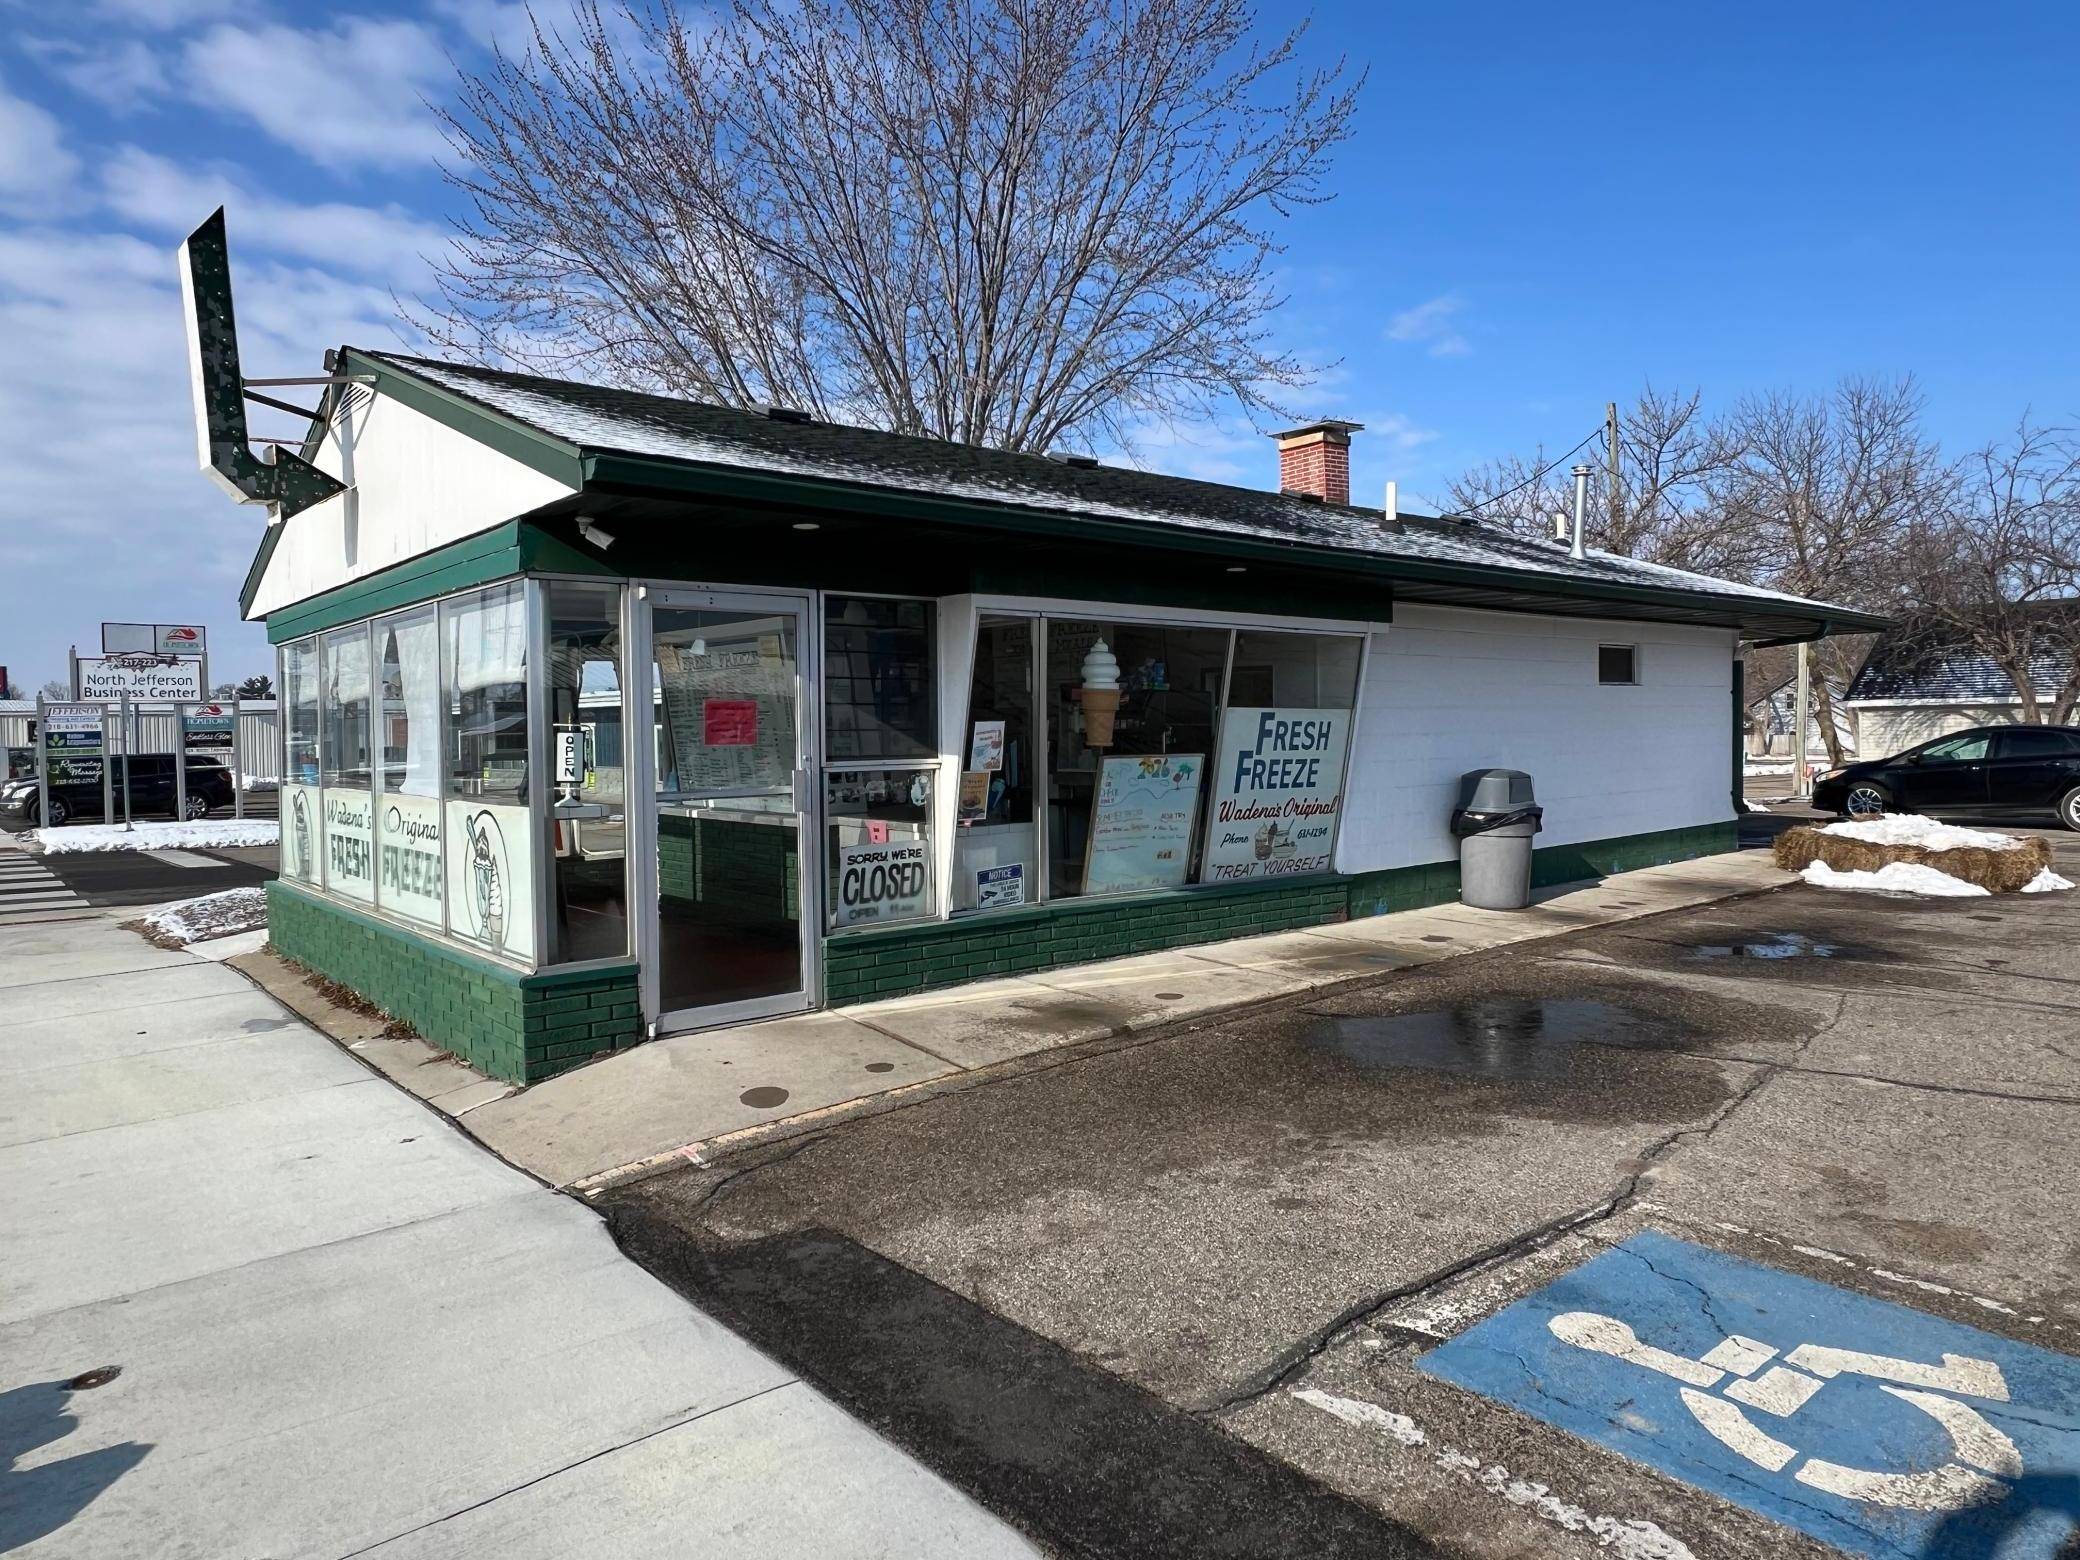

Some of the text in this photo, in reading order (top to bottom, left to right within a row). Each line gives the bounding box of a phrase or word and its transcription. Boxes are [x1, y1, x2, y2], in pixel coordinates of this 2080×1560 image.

[84, 687, 197, 698] Business Center
[87, 674, 193, 686] North Jefferson
[44, 707, 100, 718] JEFFERSON
[1255, 711, 1331, 755] FRESH
[564, 735, 576, 777] OPEN
[1233, 750, 1320, 793] FREEZE
[327, 799, 372, 830] Wadena's
[1219, 795, 1340, 822] Wadena's Original
[891, 847, 923, 861] WE'RE
[1220, 833, 1249, 848] Phone
[330, 833, 371, 881] FRESH
[842, 861, 925, 906] CLOSED
